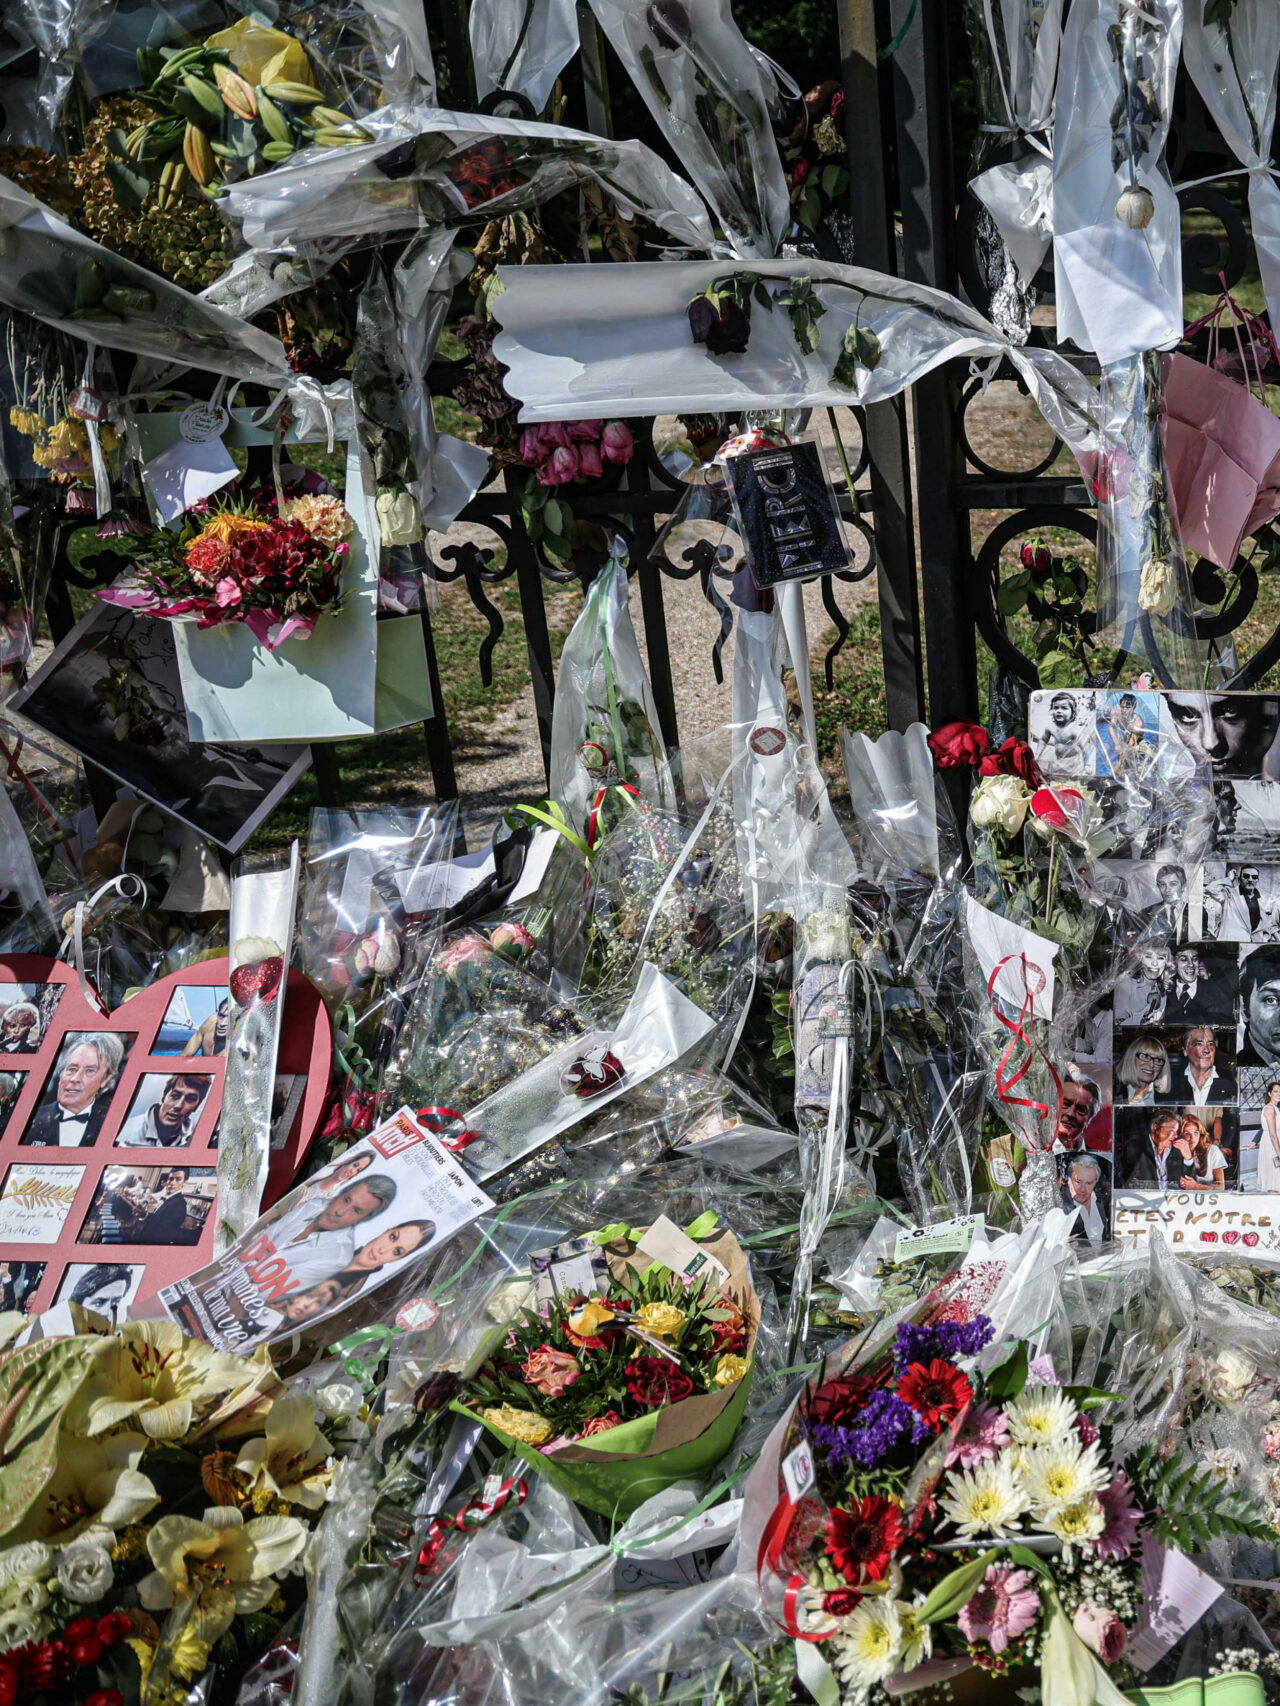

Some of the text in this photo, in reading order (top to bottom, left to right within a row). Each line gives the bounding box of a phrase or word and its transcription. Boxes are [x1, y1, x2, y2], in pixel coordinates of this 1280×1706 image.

[752, 451, 823, 577] MERCI
[395, 1119, 414, 1137] PARIS
[423, 1140, 446, 1165] BIJOUTIERS
[448, 1171, 464, 1188] JAPON
[1165, 1193, 1219, 1206] VOUS
[1116, 1209, 1176, 1223] ETES
[1185, 1210, 1272, 1228] NOTRE
[240, 1234, 301, 1303] DELON
